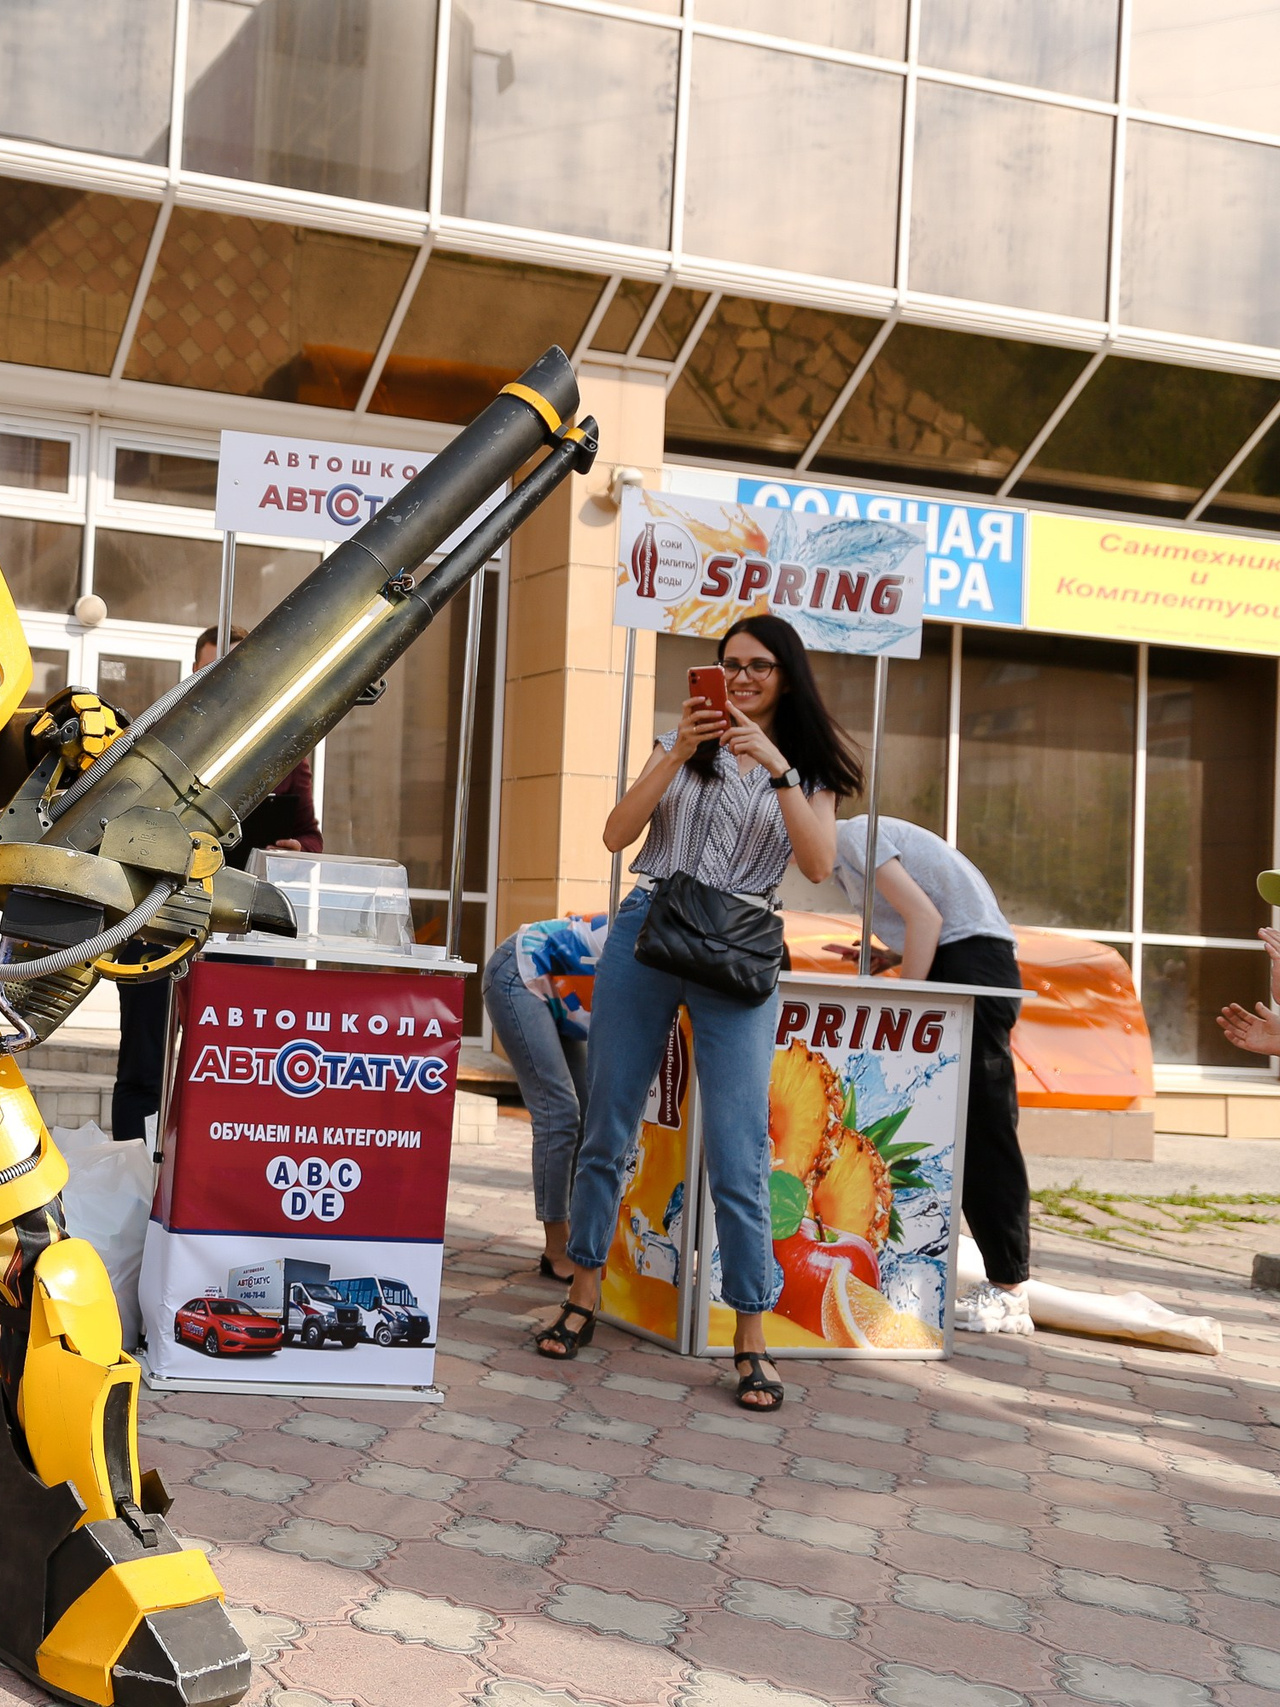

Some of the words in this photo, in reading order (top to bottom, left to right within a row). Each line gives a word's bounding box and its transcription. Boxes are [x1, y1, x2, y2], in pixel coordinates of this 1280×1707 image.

[660, 539, 683, 550] СОКИ
[659, 557, 697, 570] НАПИТКИ
[658, 575, 682, 587] ВОДЫ
[700, 554, 906, 615] SPRING
[198, 1005, 444, 1038] АВТОШКОЛА
[209, 1121, 291, 1144] ОБУЧАЕМ
[294, 1125, 319, 1145] НА
[322, 1126, 422, 1150] КАТЕГОРИИ
